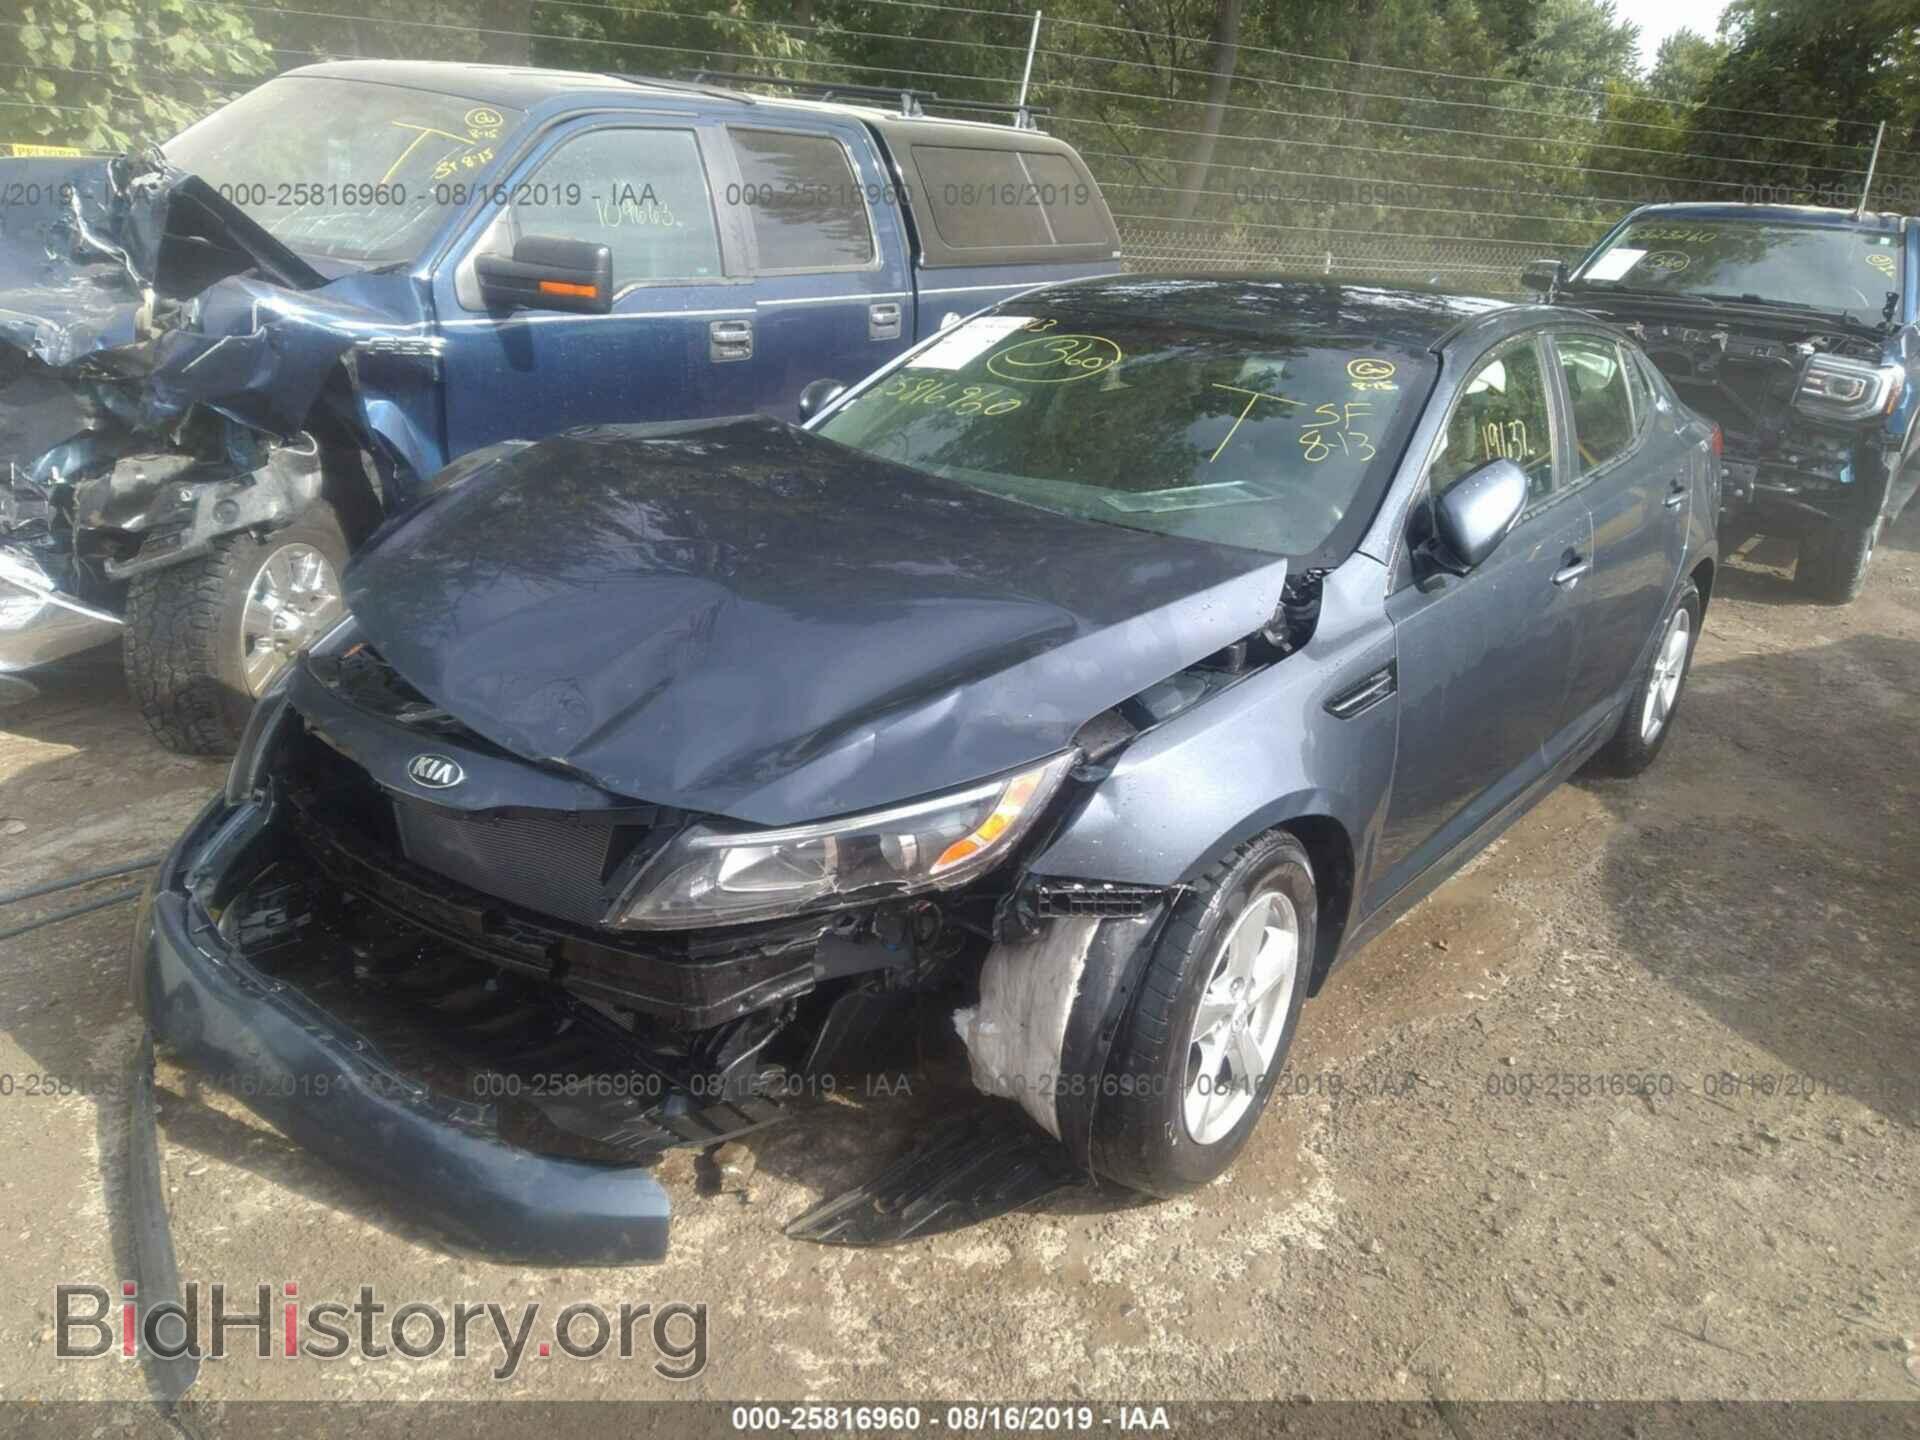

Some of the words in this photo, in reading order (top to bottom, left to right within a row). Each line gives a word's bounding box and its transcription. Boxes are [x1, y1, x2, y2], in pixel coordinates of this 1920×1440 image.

[1005, 338, 1103, 369] 360
[1211, 382, 1307, 463] T
[1301, 402, 1376, 430] SF
[1299, 430, 1376, 461] 8-13
[412, 756, 453, 784] KIA
